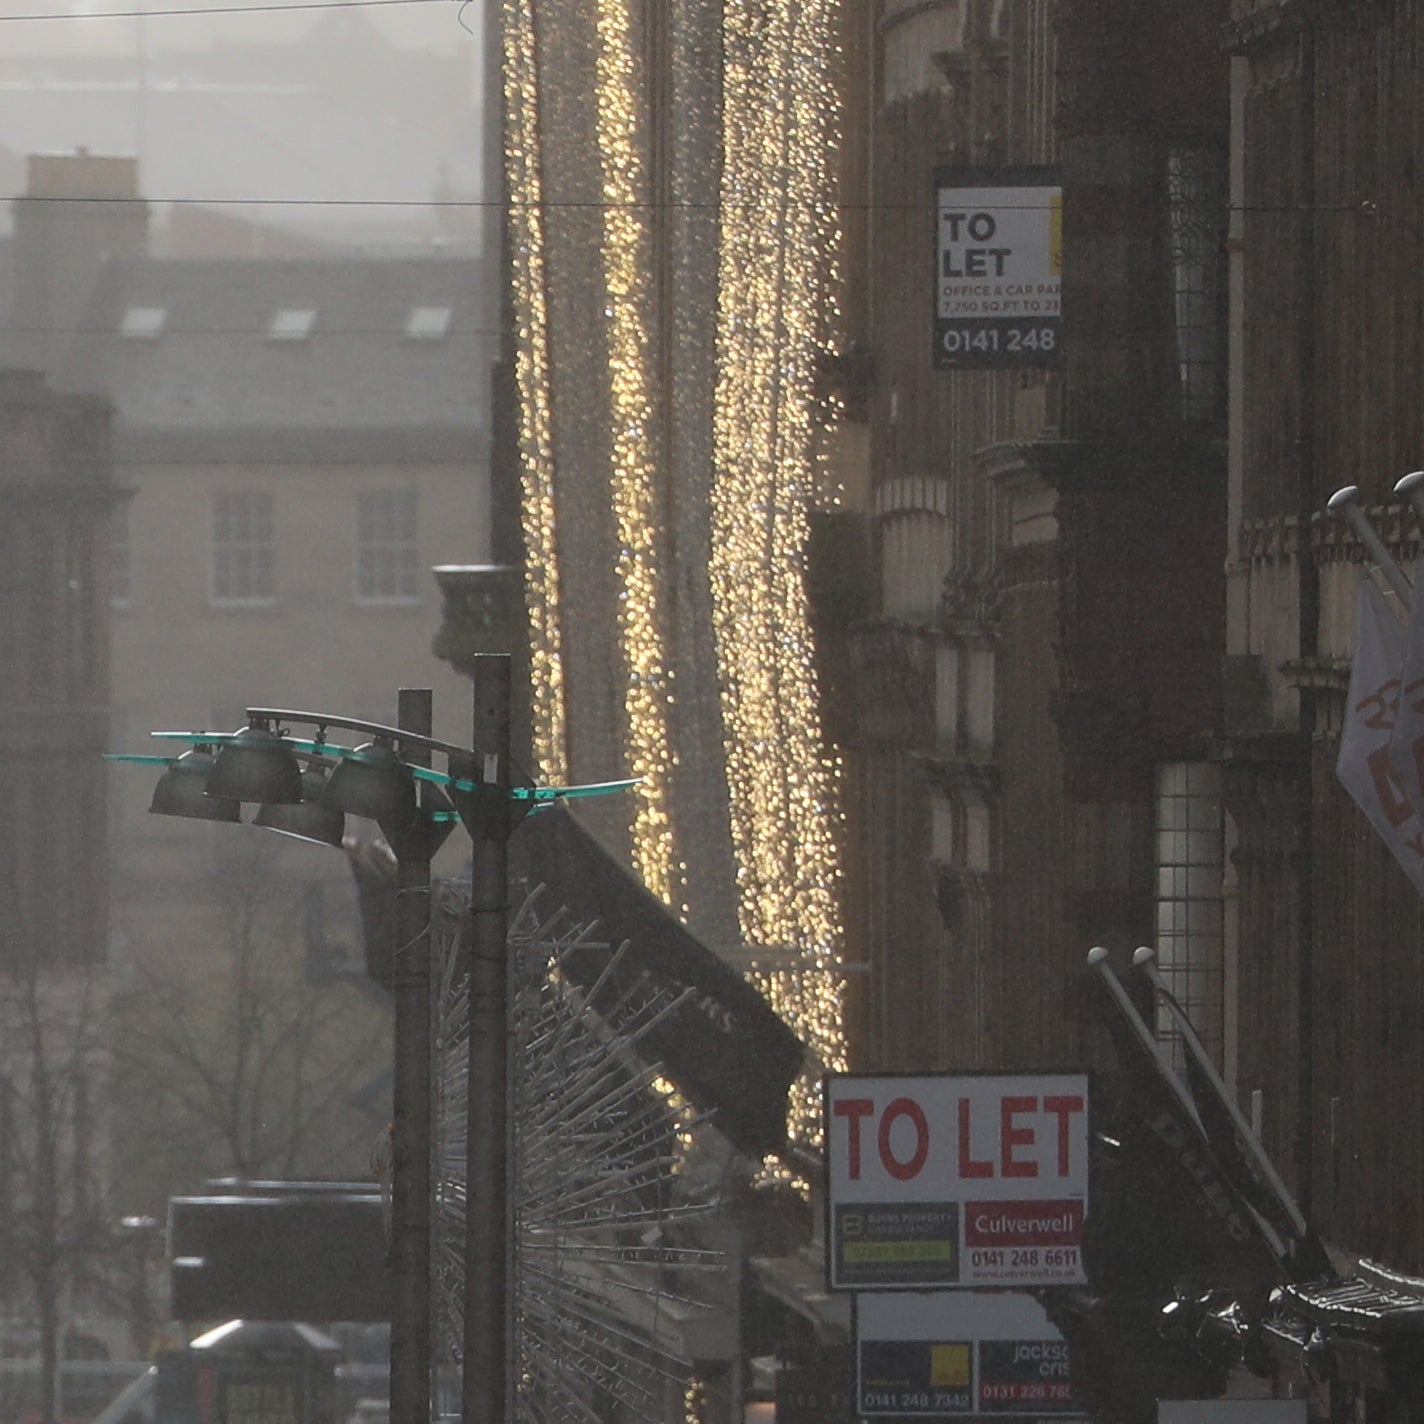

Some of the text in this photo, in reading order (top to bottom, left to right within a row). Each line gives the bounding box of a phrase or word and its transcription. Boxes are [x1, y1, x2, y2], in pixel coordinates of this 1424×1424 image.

[943, 212, 996, 242] TO
[943, 248, 1012, 277] LET
[943, 285, 989, 297] OFFICE
[1005, 284, 1032, 295] CAR
[1023, 300, 1040, 310] TO
[943, 328, 1055, 352] 0141 248
[833, 1095, 1084, 1181] TO LET
[974, 1214, 1074, 1233] Culverwell
[971, 1249, 1077, 1266] 0141 248 6611
[864, 1393, 897, 1407] 0141
[902, 1393, 928, 1407] 248
[934, 1393, 970, 1407] 7342
[983, 1383, 1017, 1399] 0131
[1020, 1383, 1046, 1399] 226
